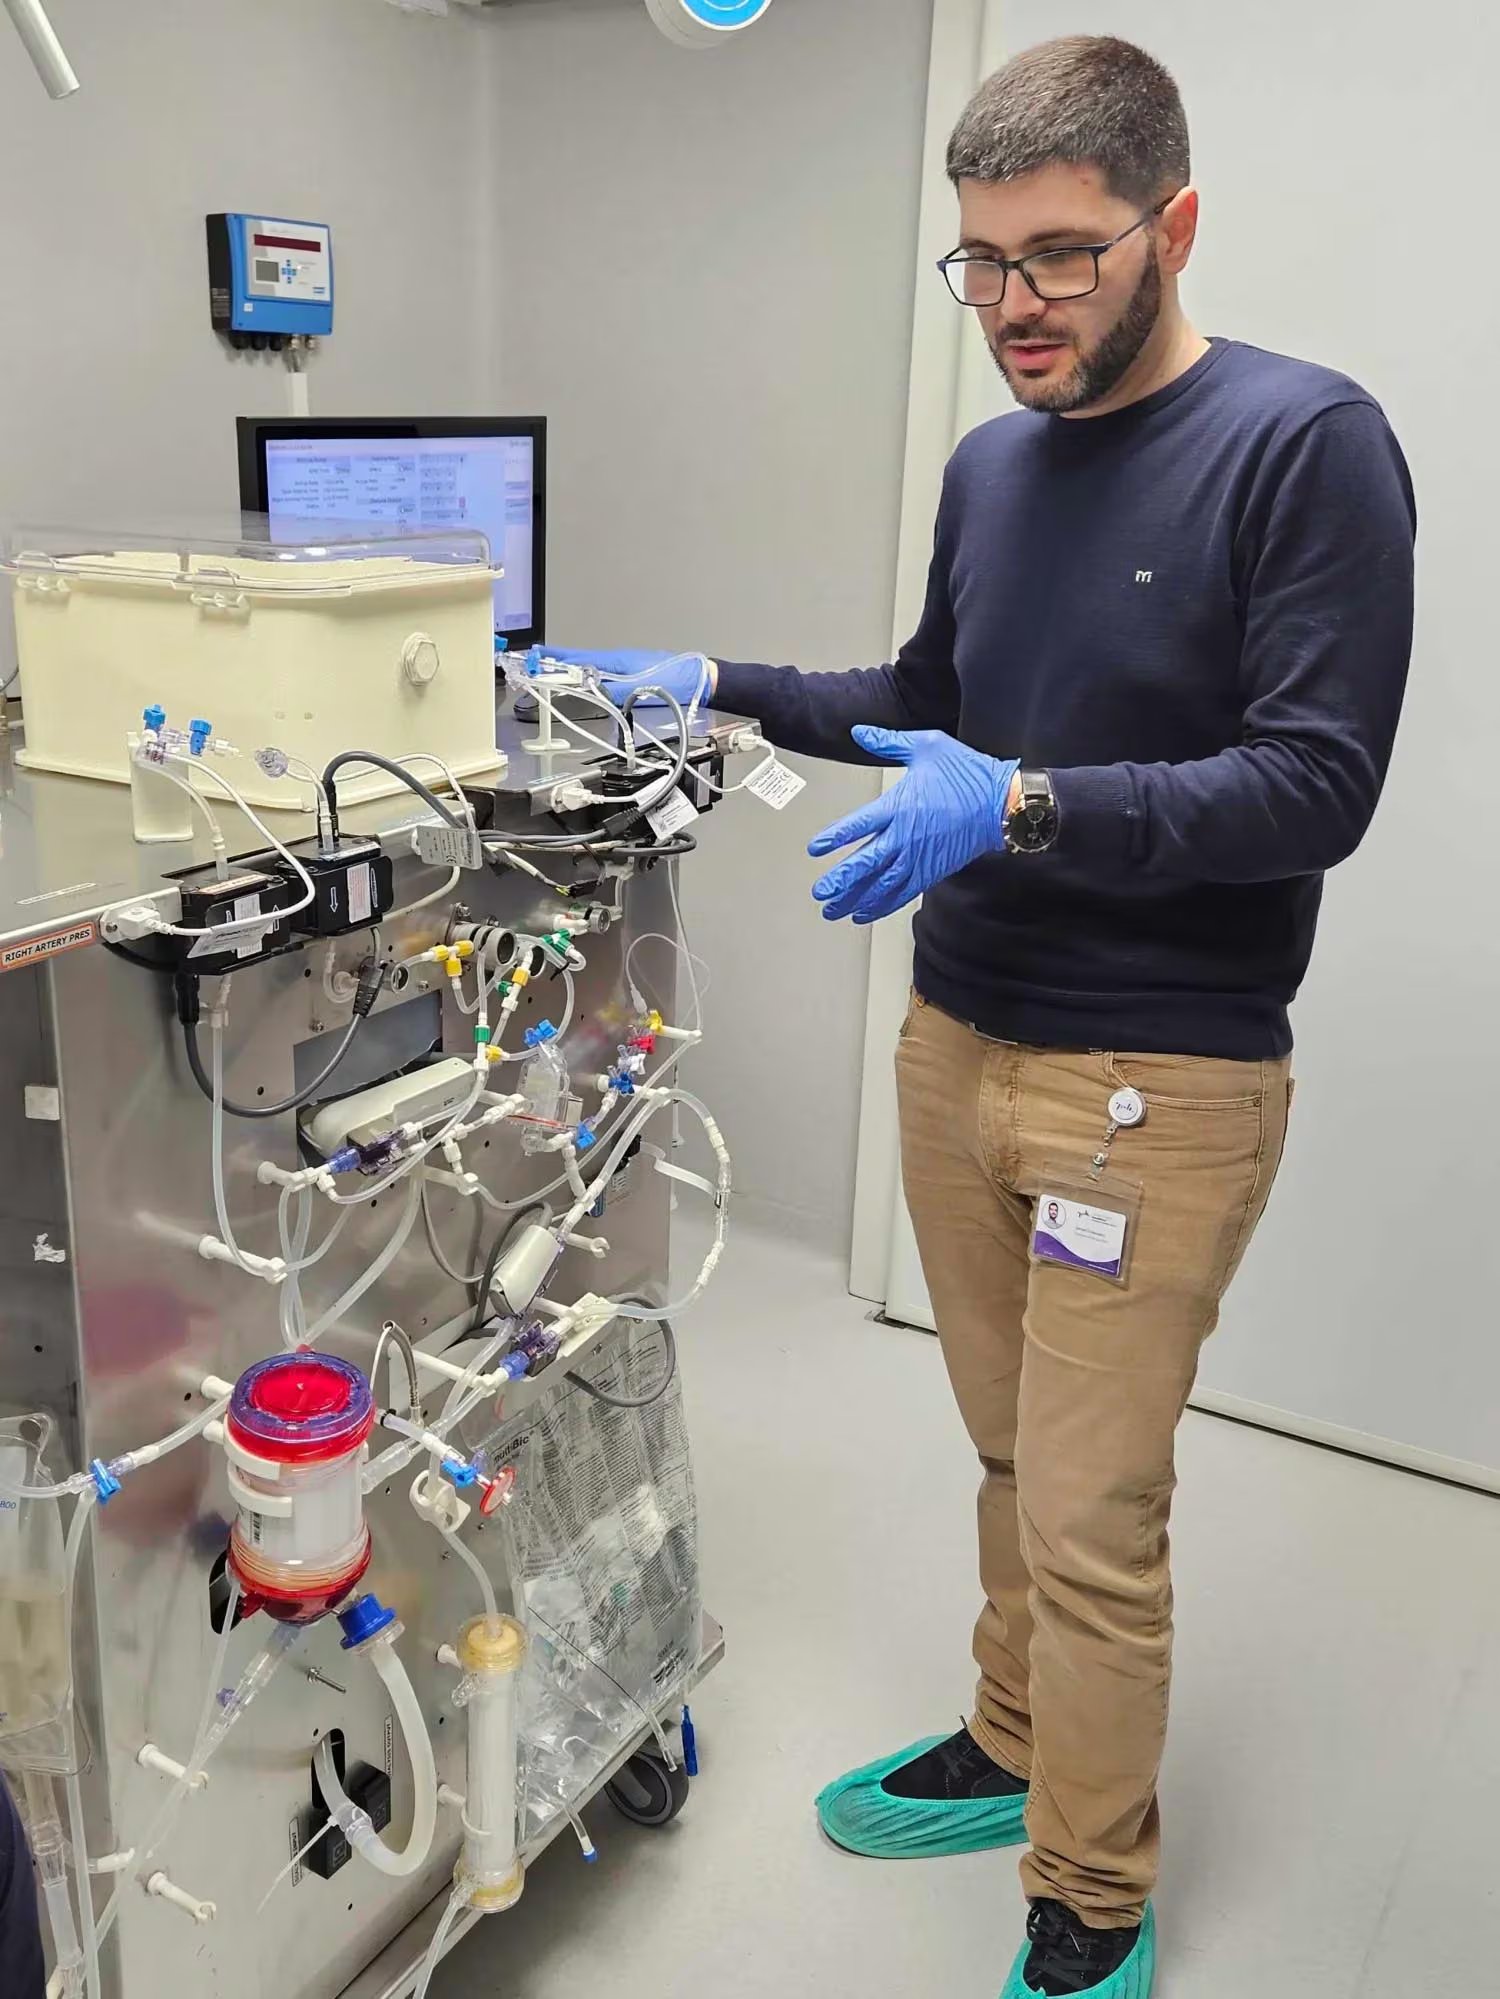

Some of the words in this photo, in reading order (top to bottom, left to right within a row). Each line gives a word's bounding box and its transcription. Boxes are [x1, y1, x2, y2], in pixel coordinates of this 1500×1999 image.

[5, 946, 33, 962] RIGHT
[34, 936, 67, 952] ARTERY
[69, 929, 91, 942] PRES
